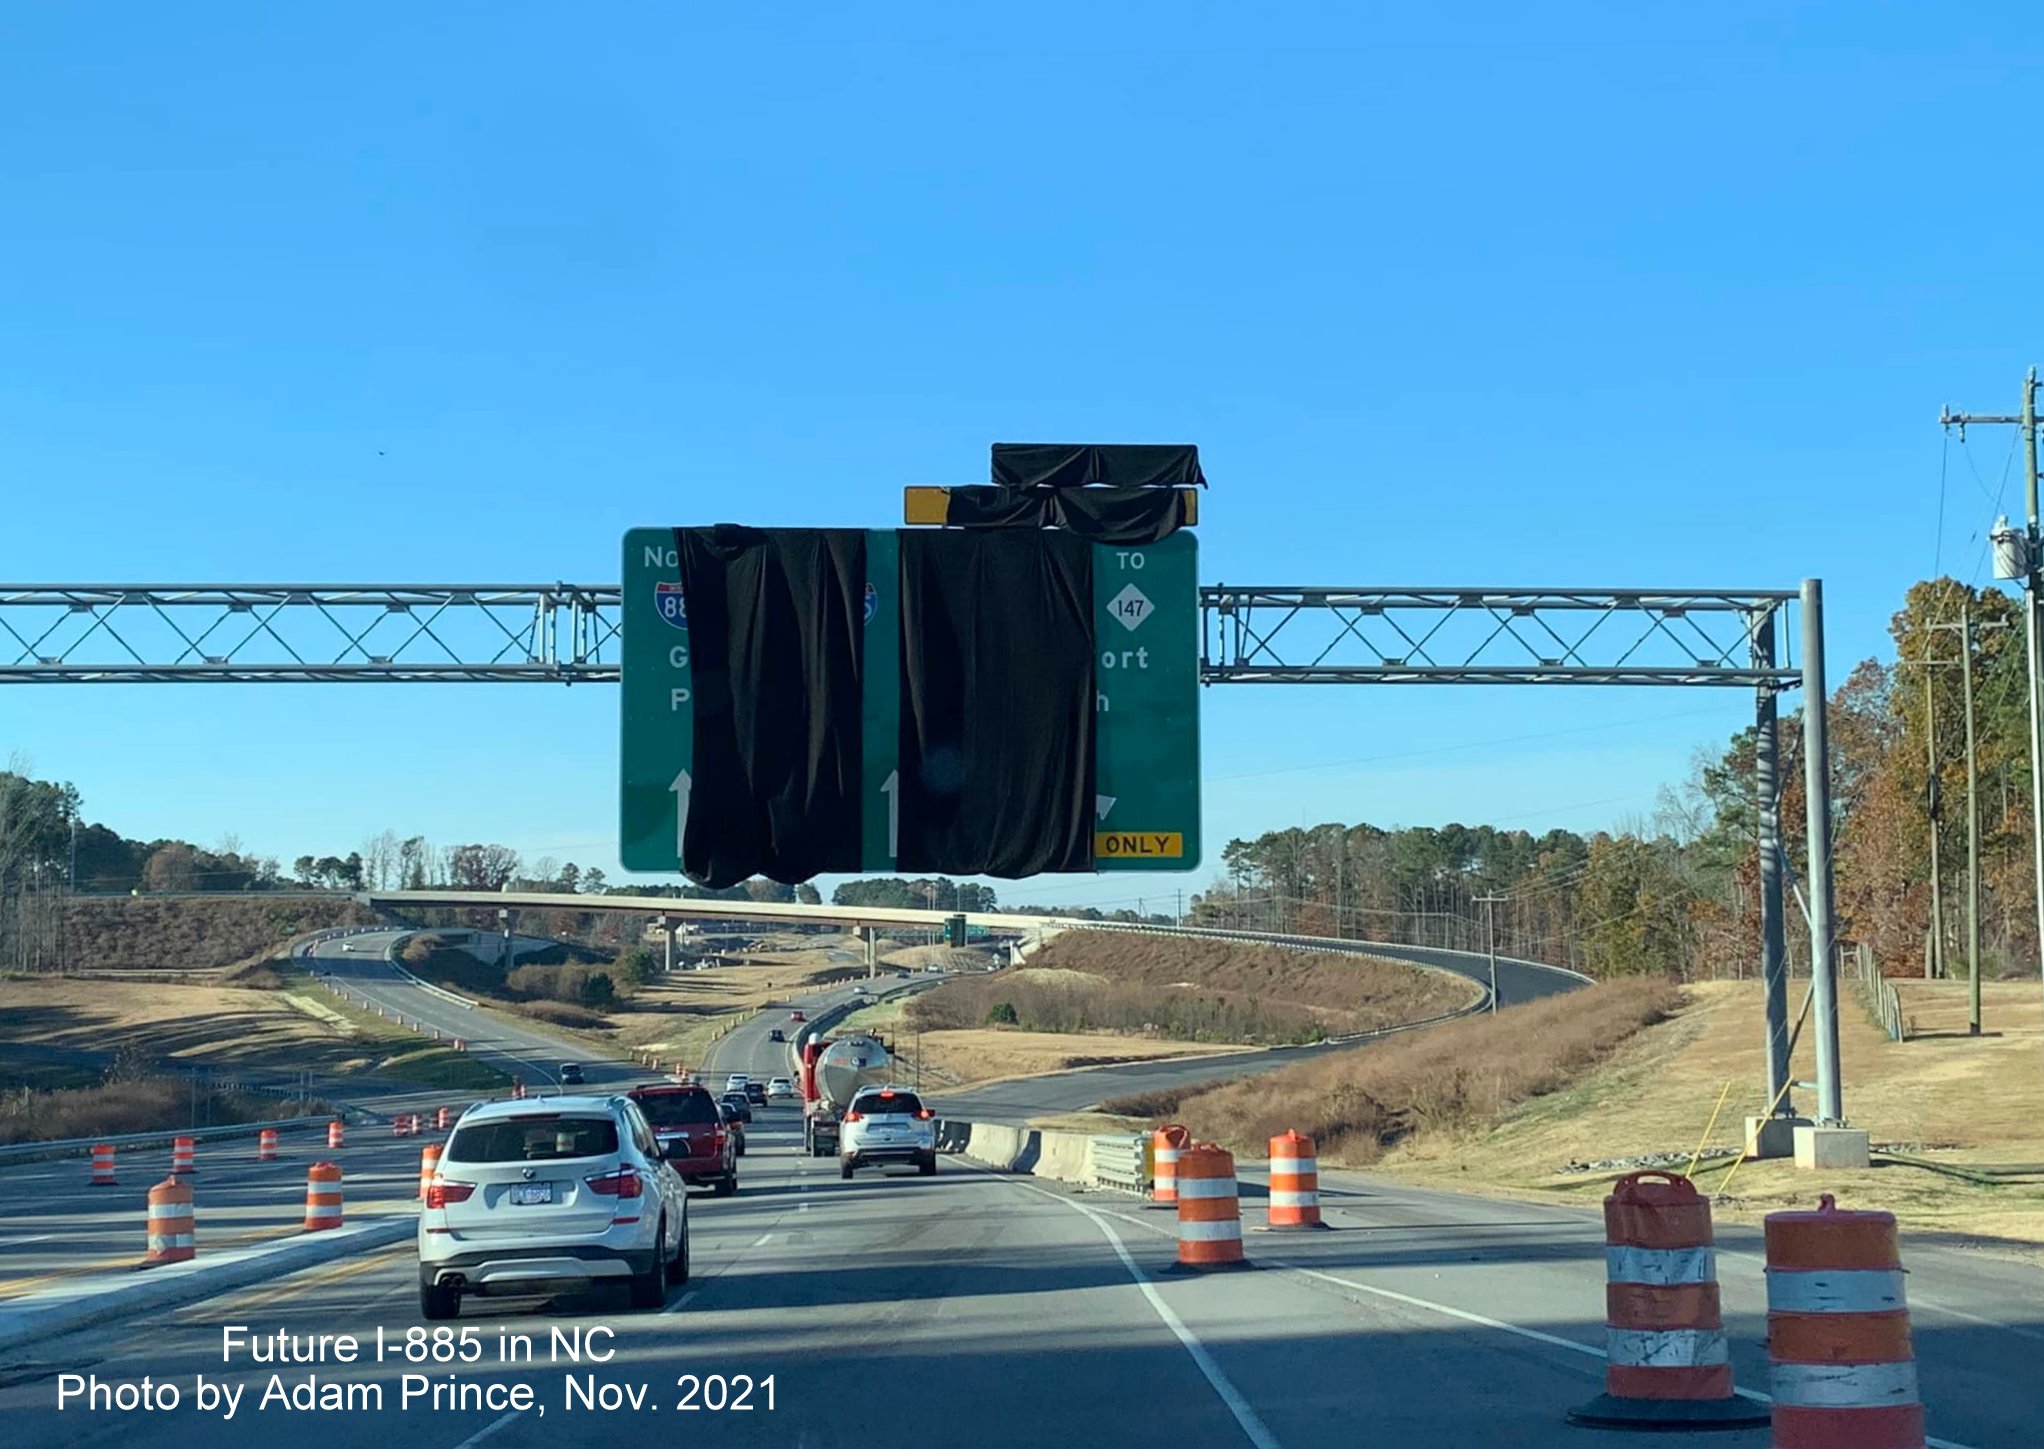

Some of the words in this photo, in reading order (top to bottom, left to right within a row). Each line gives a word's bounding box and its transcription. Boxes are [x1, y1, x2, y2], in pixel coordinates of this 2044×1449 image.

[1116, 552, 1145, 570] TO
[1118, 600, 1144, 617] 147
[1106, 835, 1170, 854] ONLY
